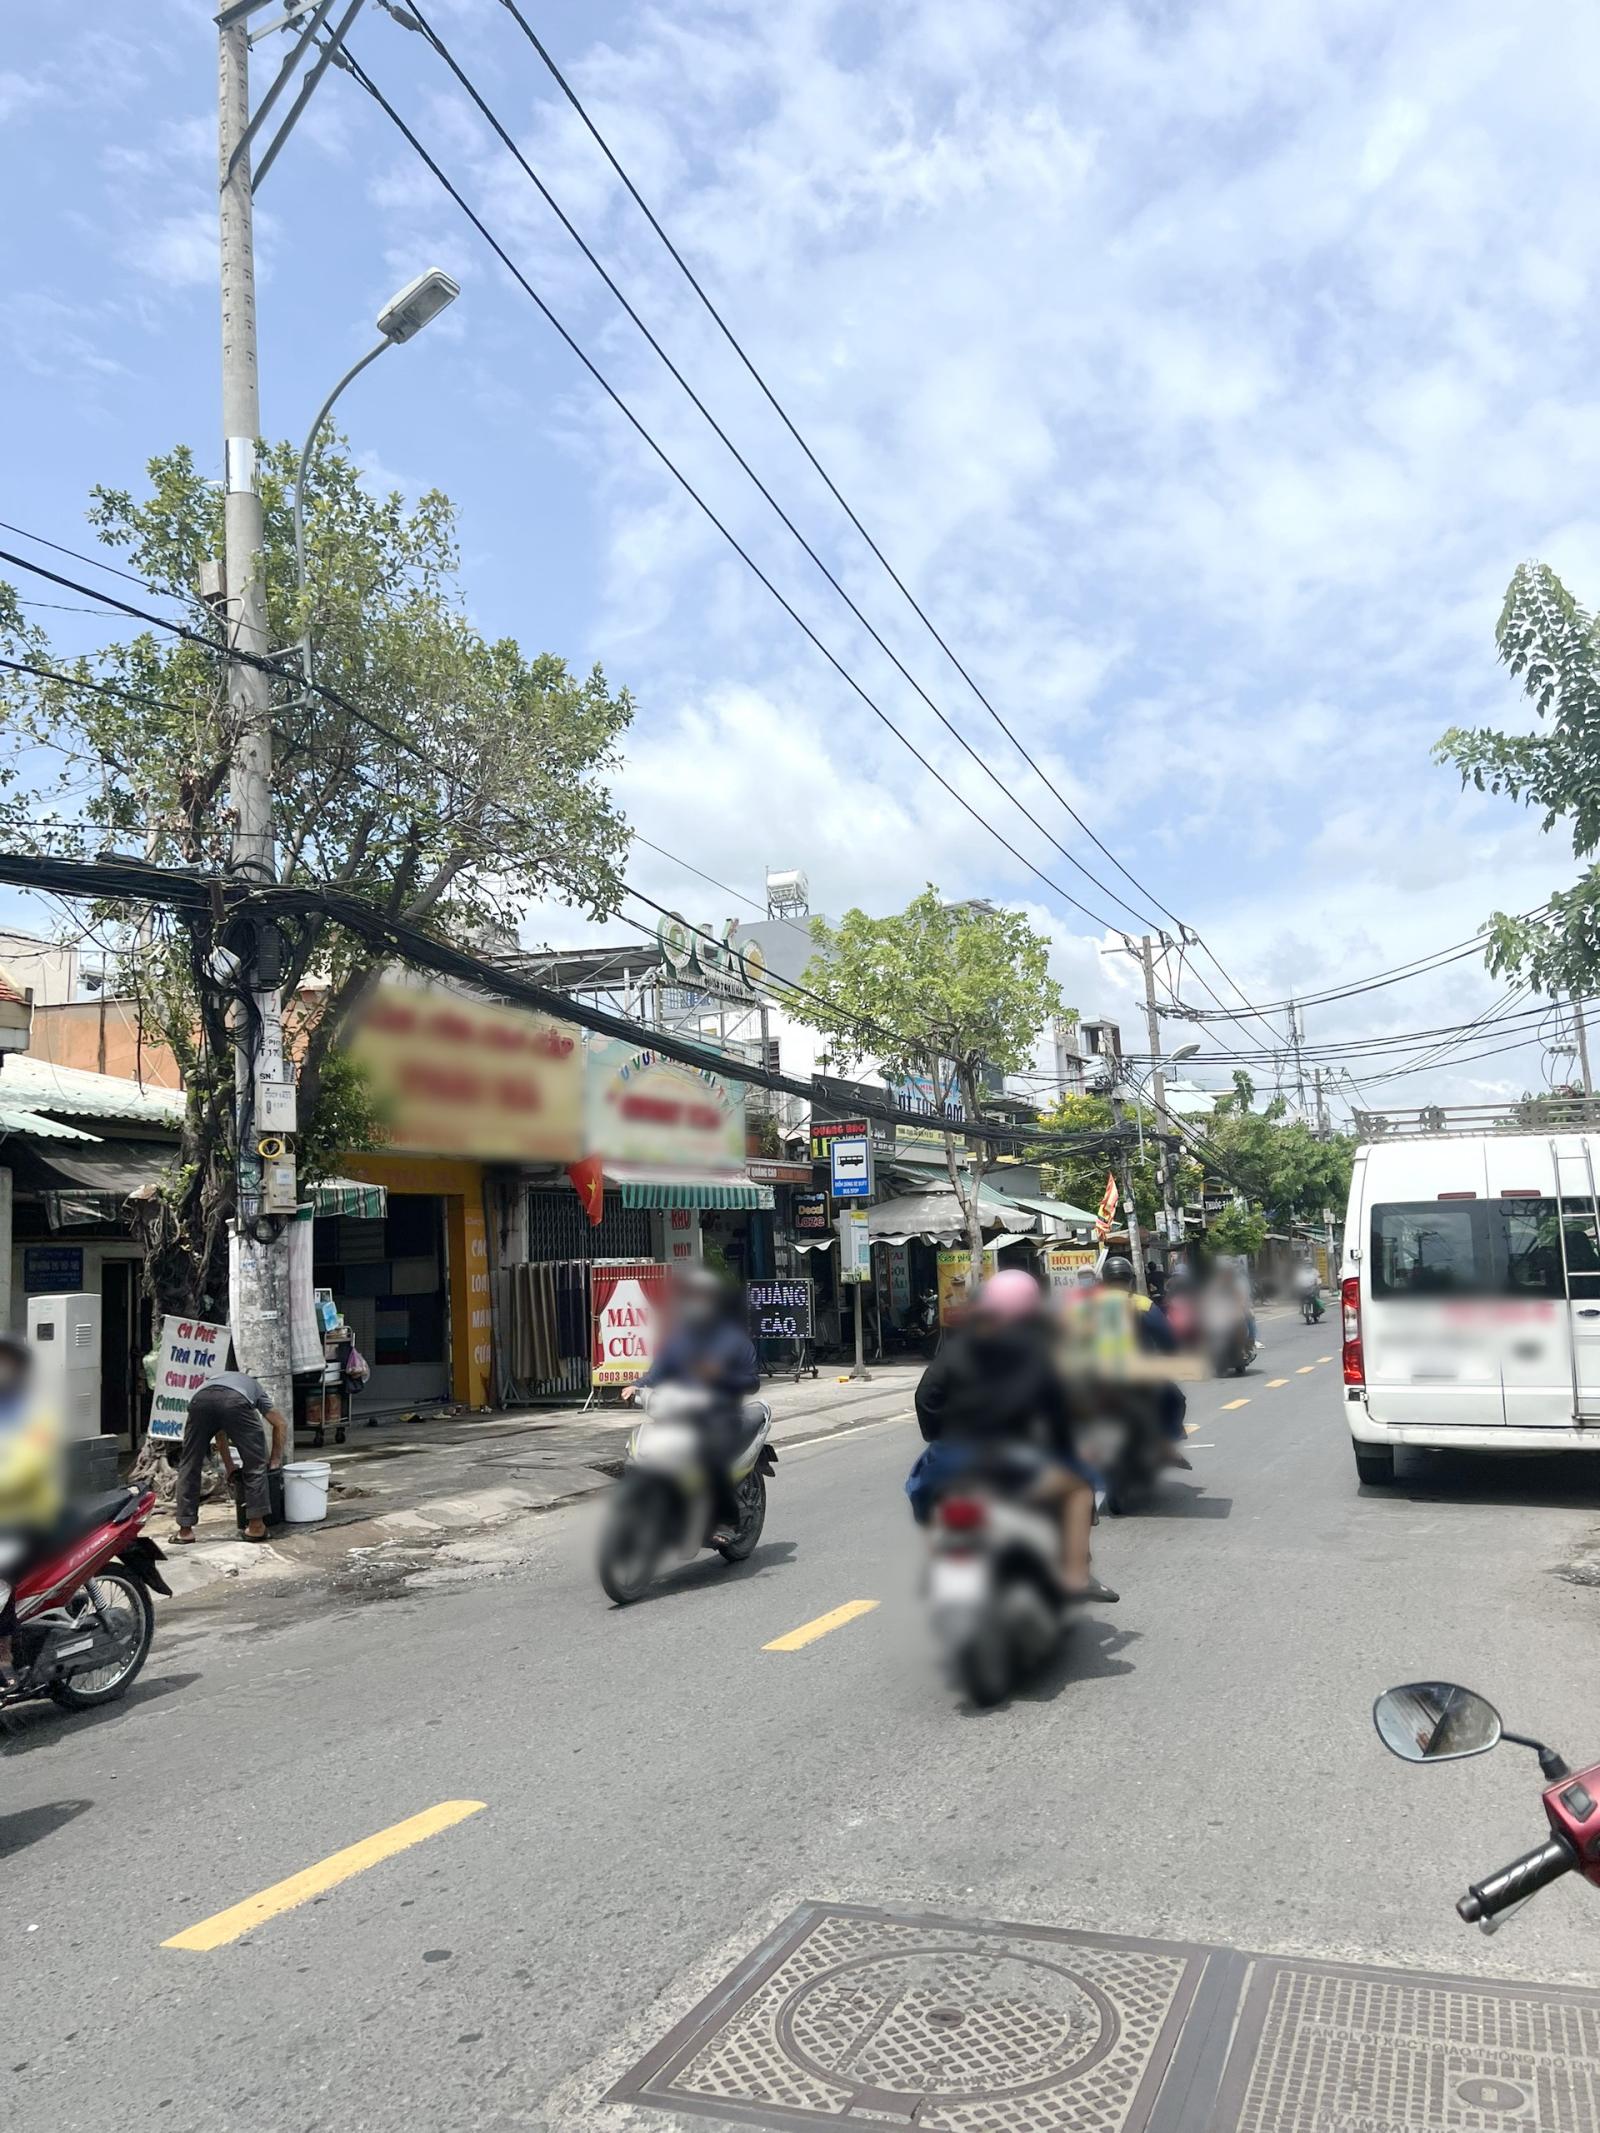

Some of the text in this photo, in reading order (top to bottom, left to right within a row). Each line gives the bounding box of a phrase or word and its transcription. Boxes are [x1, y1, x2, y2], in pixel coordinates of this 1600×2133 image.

[812, 1137, 844, 1159] LE
[607, 1302, 648, 1328] MÀN
[608, 1331, 648, 1357] CỬA
[598, 1371, 621, 1382] 0903
